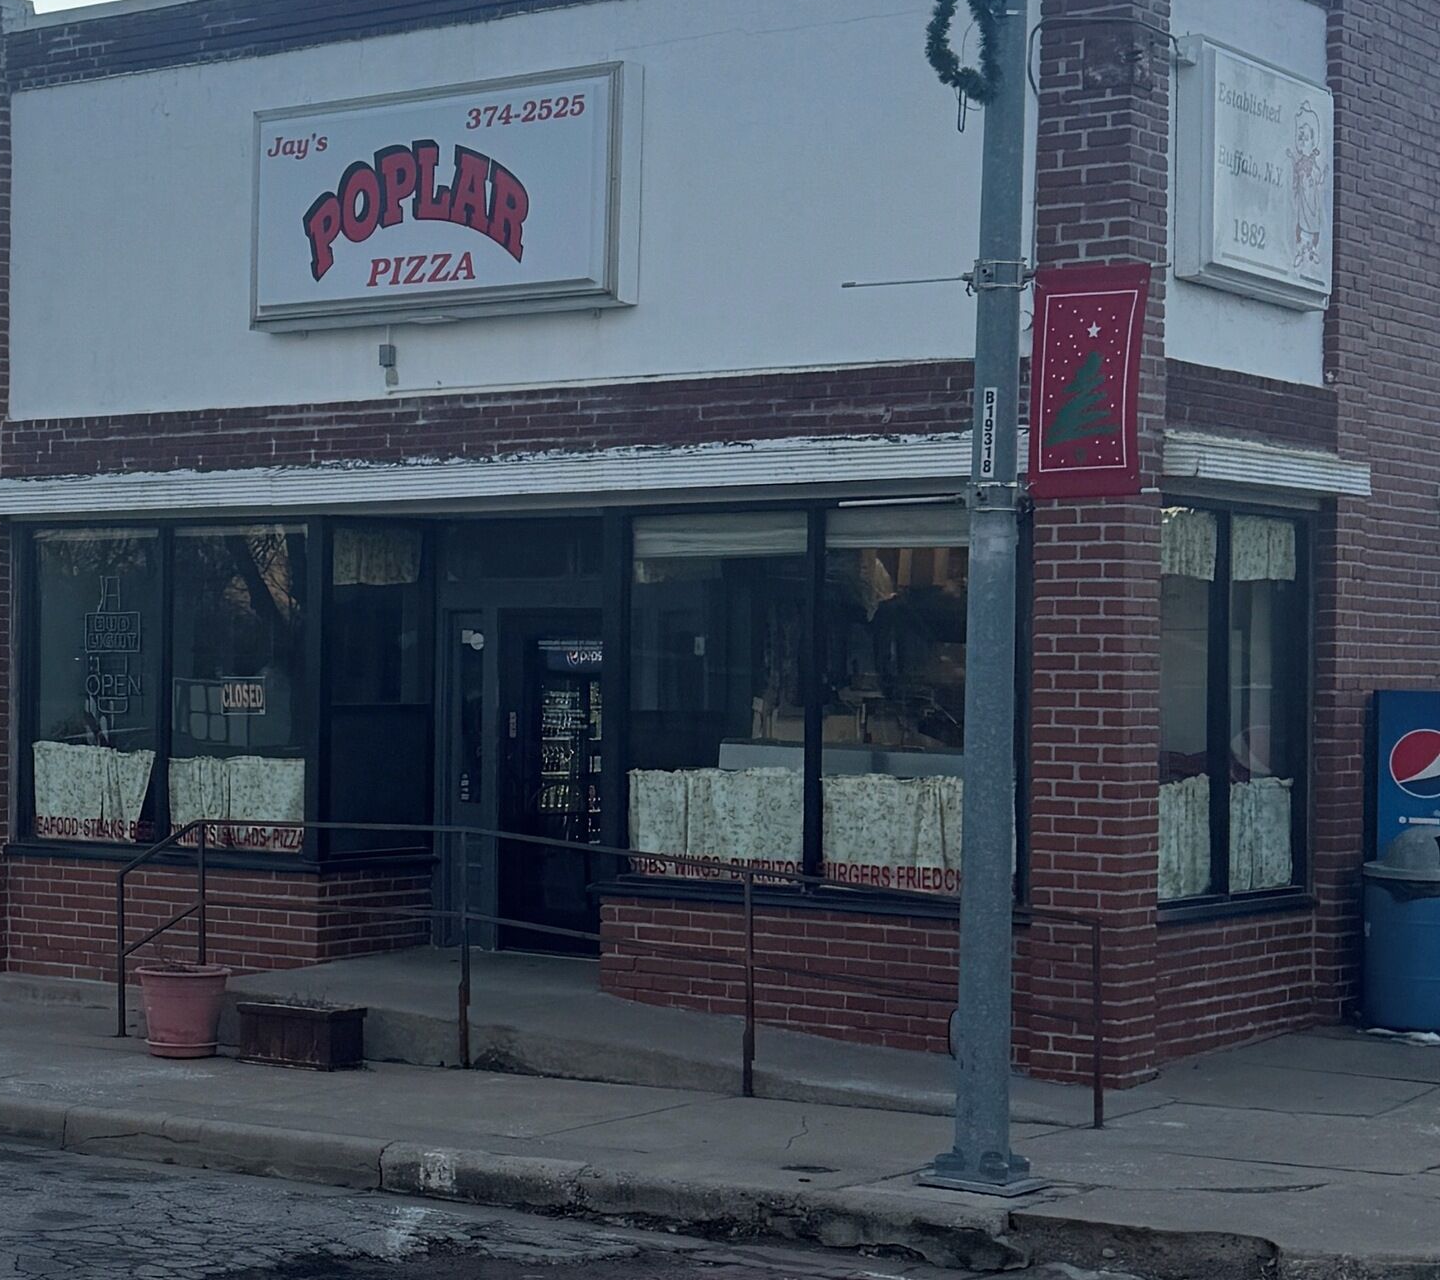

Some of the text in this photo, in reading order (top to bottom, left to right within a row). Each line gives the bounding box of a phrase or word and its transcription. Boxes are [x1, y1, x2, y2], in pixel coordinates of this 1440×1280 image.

[465, 94, 586, 130] 374-2525
[1217, 81, 1281, 124] Established
[267, 132, 328, 160] Jay's
[1217, 144, 1262, 181] Buffalo,
[302, 139, 529, 282] POPLAR
[1232, 218, 1266, 250] 1982
[366, 251, 476, 287] PIZZA
[85, 674, 142, 696] OPEN
[222, 683, 264, 708] CLOSED
[35, 816, 78, 836] EAFOOD
